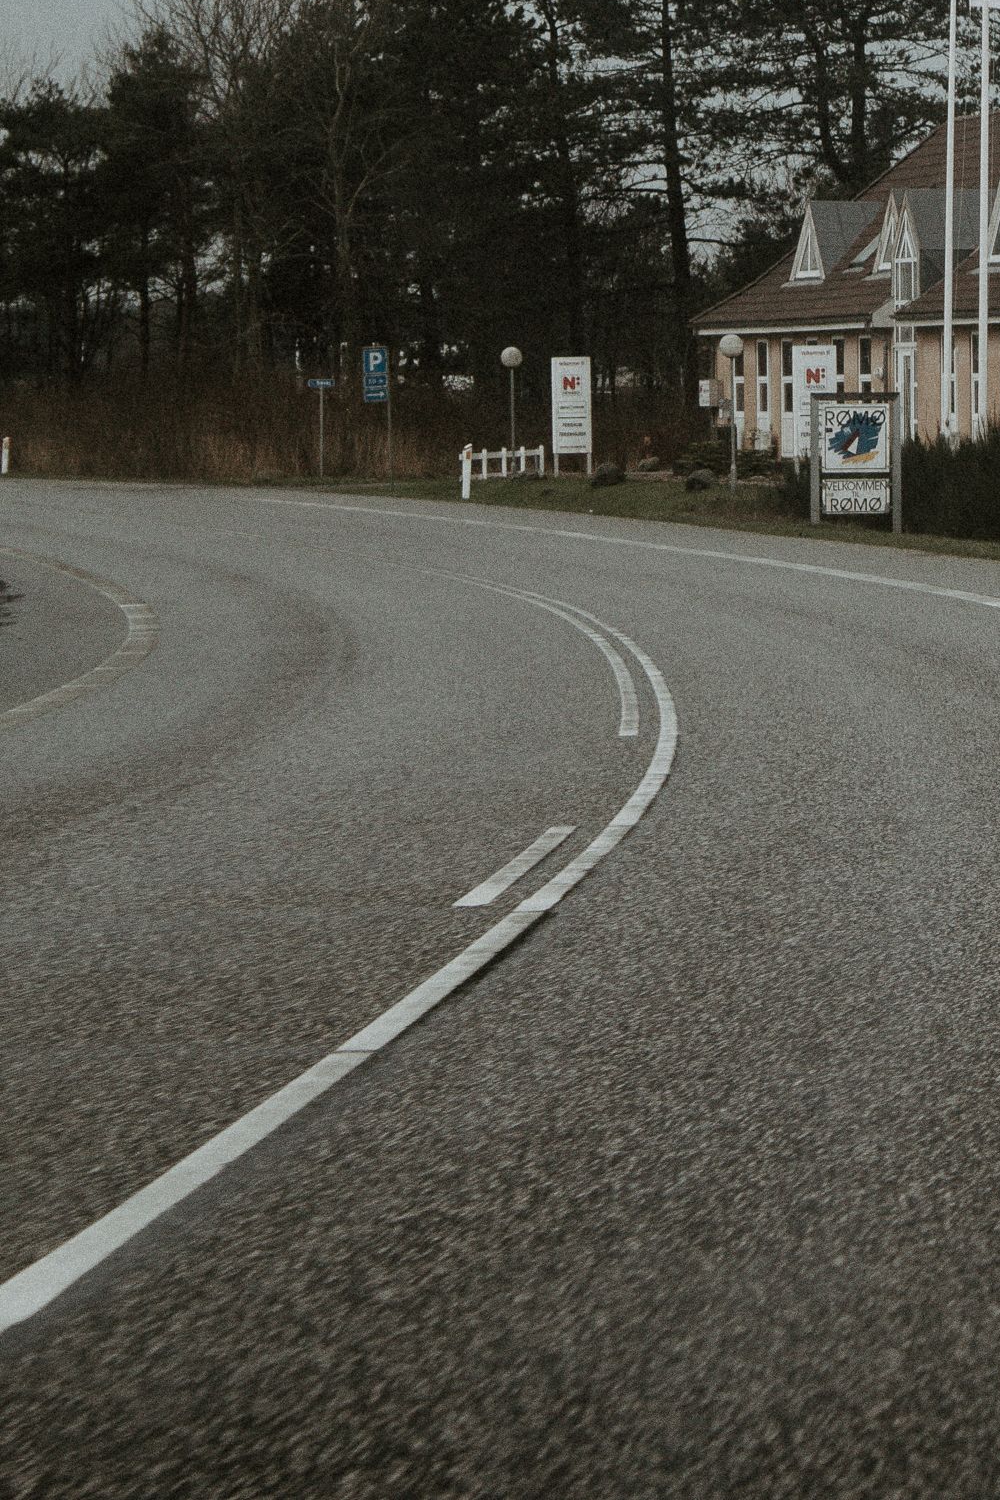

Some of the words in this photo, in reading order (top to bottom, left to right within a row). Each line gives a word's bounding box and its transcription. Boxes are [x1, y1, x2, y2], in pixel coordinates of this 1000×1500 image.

[369, 352, 382, 371] P
[825, 410, 886, 427] RØMØ
[826, 481, 887, 491] VELKOMMEN
[830, 497, 882, 511] RØMØ
